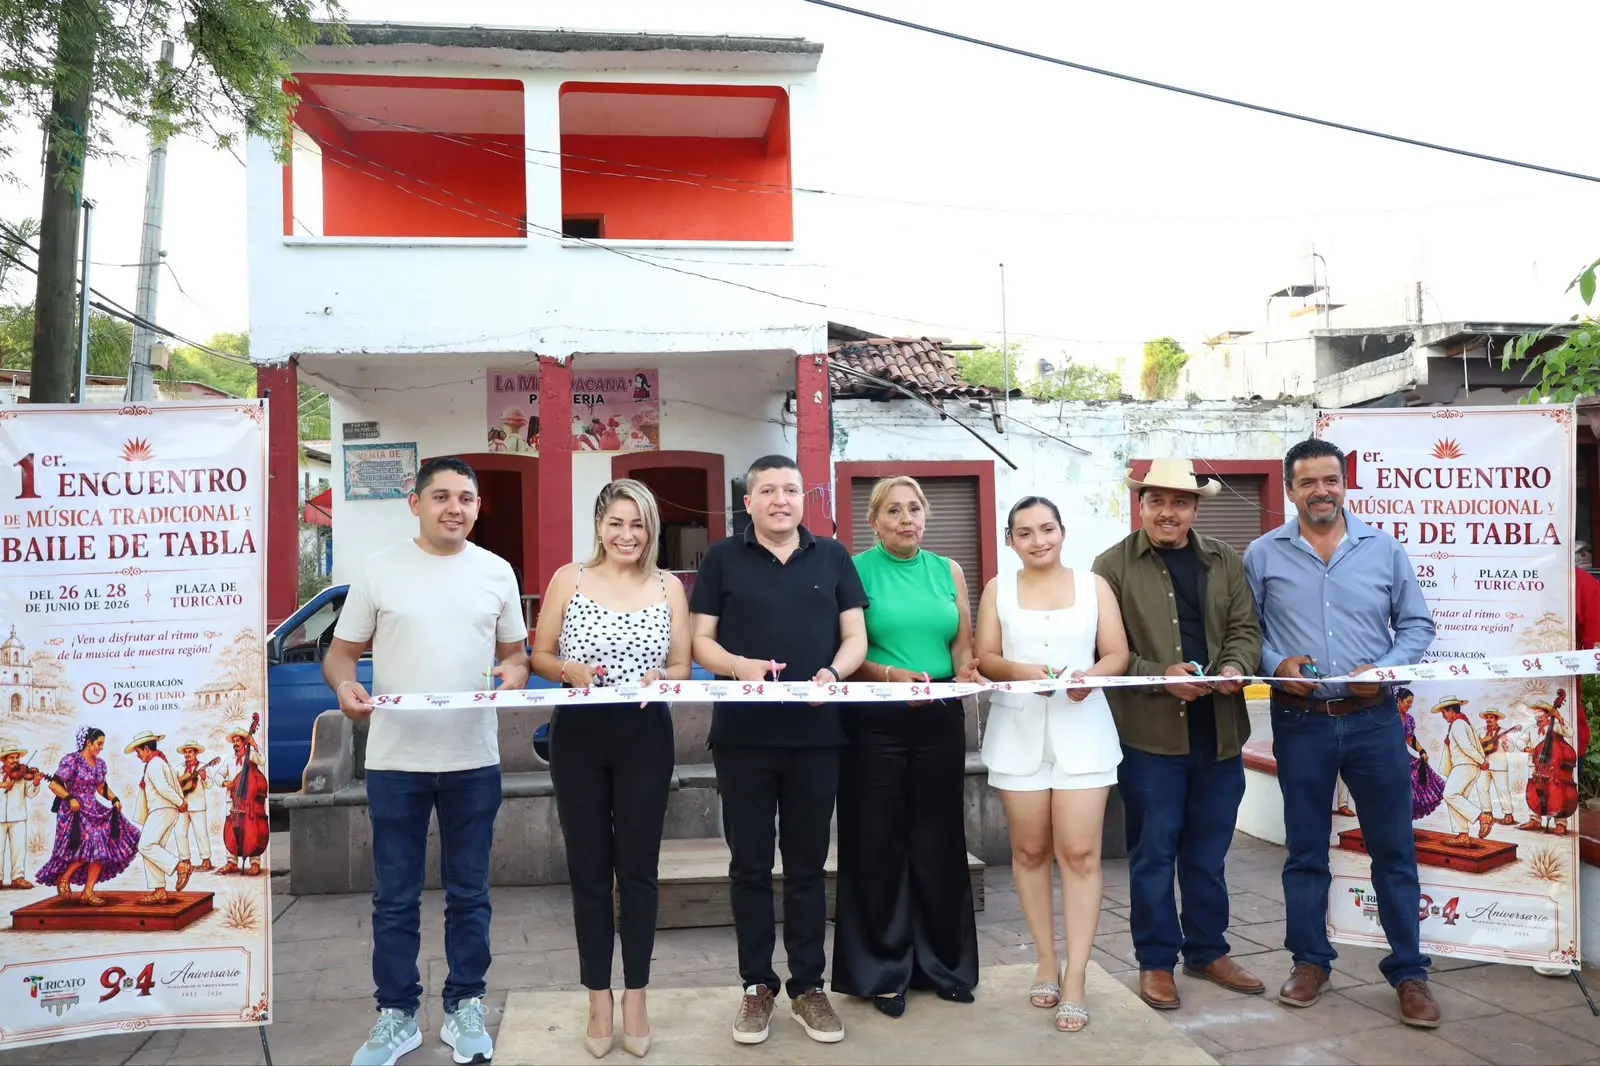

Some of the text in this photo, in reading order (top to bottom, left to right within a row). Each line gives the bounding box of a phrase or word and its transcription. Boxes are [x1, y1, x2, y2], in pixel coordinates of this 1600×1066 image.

[494, 374, 626, 392] LA MACANA
[529, 394, 605, 405] PERIA
[57, 467, 247, 498] ENCUENTRO
[1376, 466, 1552, 490] ENCUENTRO
[1348, 496, 1556, 516] MÚSICA TRADICIONAL Y
[4, 504, 252, 528] DE MÚSICA TRADICIONAL Y
[1418, 521, 1457, 545] DE
[1465, 521, 1562, 546] TABLA
[1, 529, 257, 563] BAILE DE TABLA
[1417, 565, 1435, 578] 28
[1479, 569, 1539, 579] PLAZA DE
[29, 583, 127, 600] DEL 26 AL 28
[176, 582, 237, 595] PLAZA DE
[1474, 580, 1545, 591] TURICATO
[25, 600, 130, 613] DE JUNIO DE 2026
[170, 595, 243, 609] TURICATO
[1462, 609, 1472, 619] al
[1474, 610, 1501, 619] ritmo
[1444, 622, 1478, 632] nuestra
[1481, 623, 1514, 634] región!
[71, 634, 96, 648] ¡Ven
[108, 632, 155, 645] disfrutar
[157, 632, 168, 642] al
[171, 631, 199, 641] ritmo
[57, 644, 212, 661] de la musica de nuestra región!
[113, 678, 184, 689] INAUGURACIÓN
[113, 690, 185, 708] 26 DE JUNIO
[161, 702, 181, 711] HRS.
[1465, 902, 1548, 922] Aniversario
[160, 961, 241, 984] Aniversario
